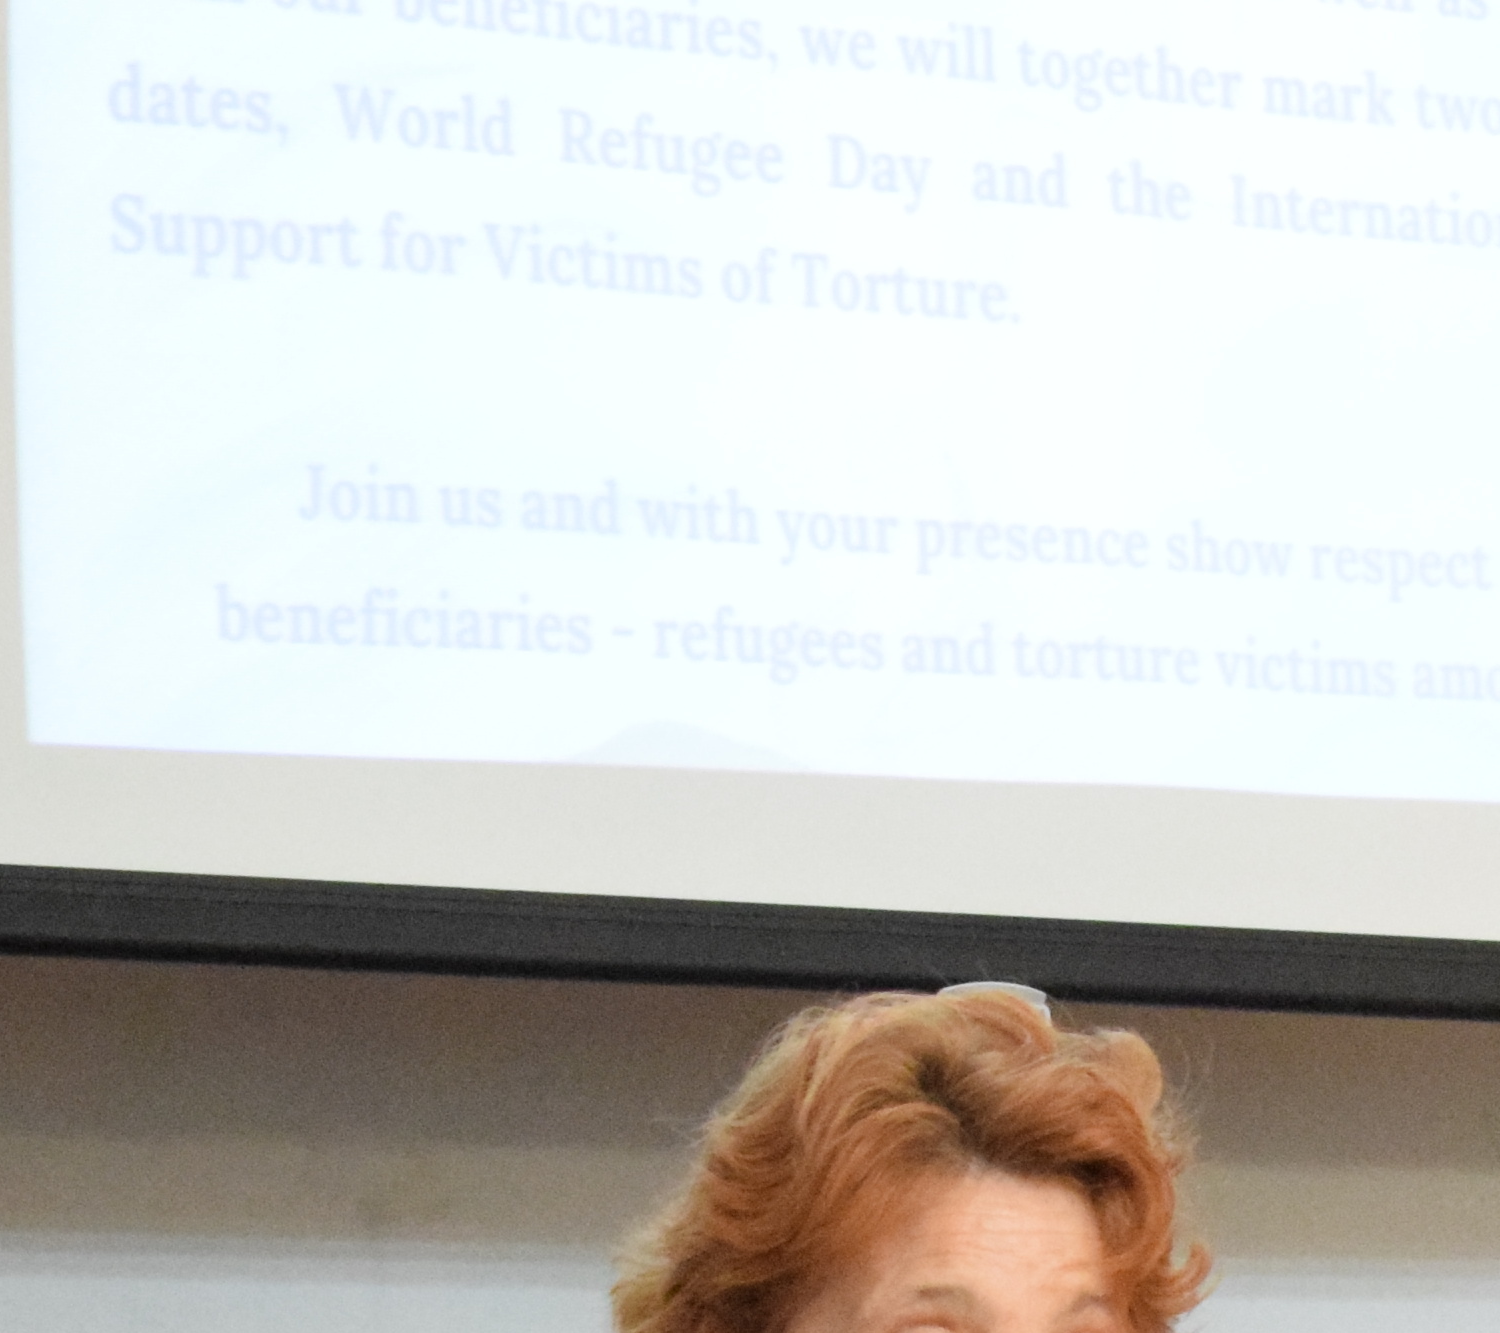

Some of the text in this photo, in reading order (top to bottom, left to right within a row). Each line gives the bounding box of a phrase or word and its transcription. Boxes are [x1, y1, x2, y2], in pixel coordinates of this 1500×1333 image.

[799, 25, 879, 72] we
[896, 22, 997, 84] will
[1016, 39, 1244, 114] together
[1263, 70, 1397, 127] mark
[106, 60, 293, 149] dates,
[332, 82, 516, 158] World
[558, 108, 786, 199] Refugee
[826, 133, 932, 214] Day
[970, 152, 1071, 210] and
[1107, 158, 1195, 223] the
[108, 193, 1021, 325] Support for Victims of Torture.
[296, 461, 424, 526] Join
[437, 480, 505, 531] us
[520, 478, 623, 538] and
[634, 483, 762, 546] with
[776, 508, 902, 568] your
[913, 517, 1151, 577] presence
[1166, 518, 1294, 578] show
[1310, 543, 1493, 604] respect
[213, 581, 594, 657] beneficiaries
[654, 605, 886, 688] refugees
[901, 621, 997, 678] and
[1012, 630, 1200, 687] torture
[1215, 637, 1397, 700] victims
